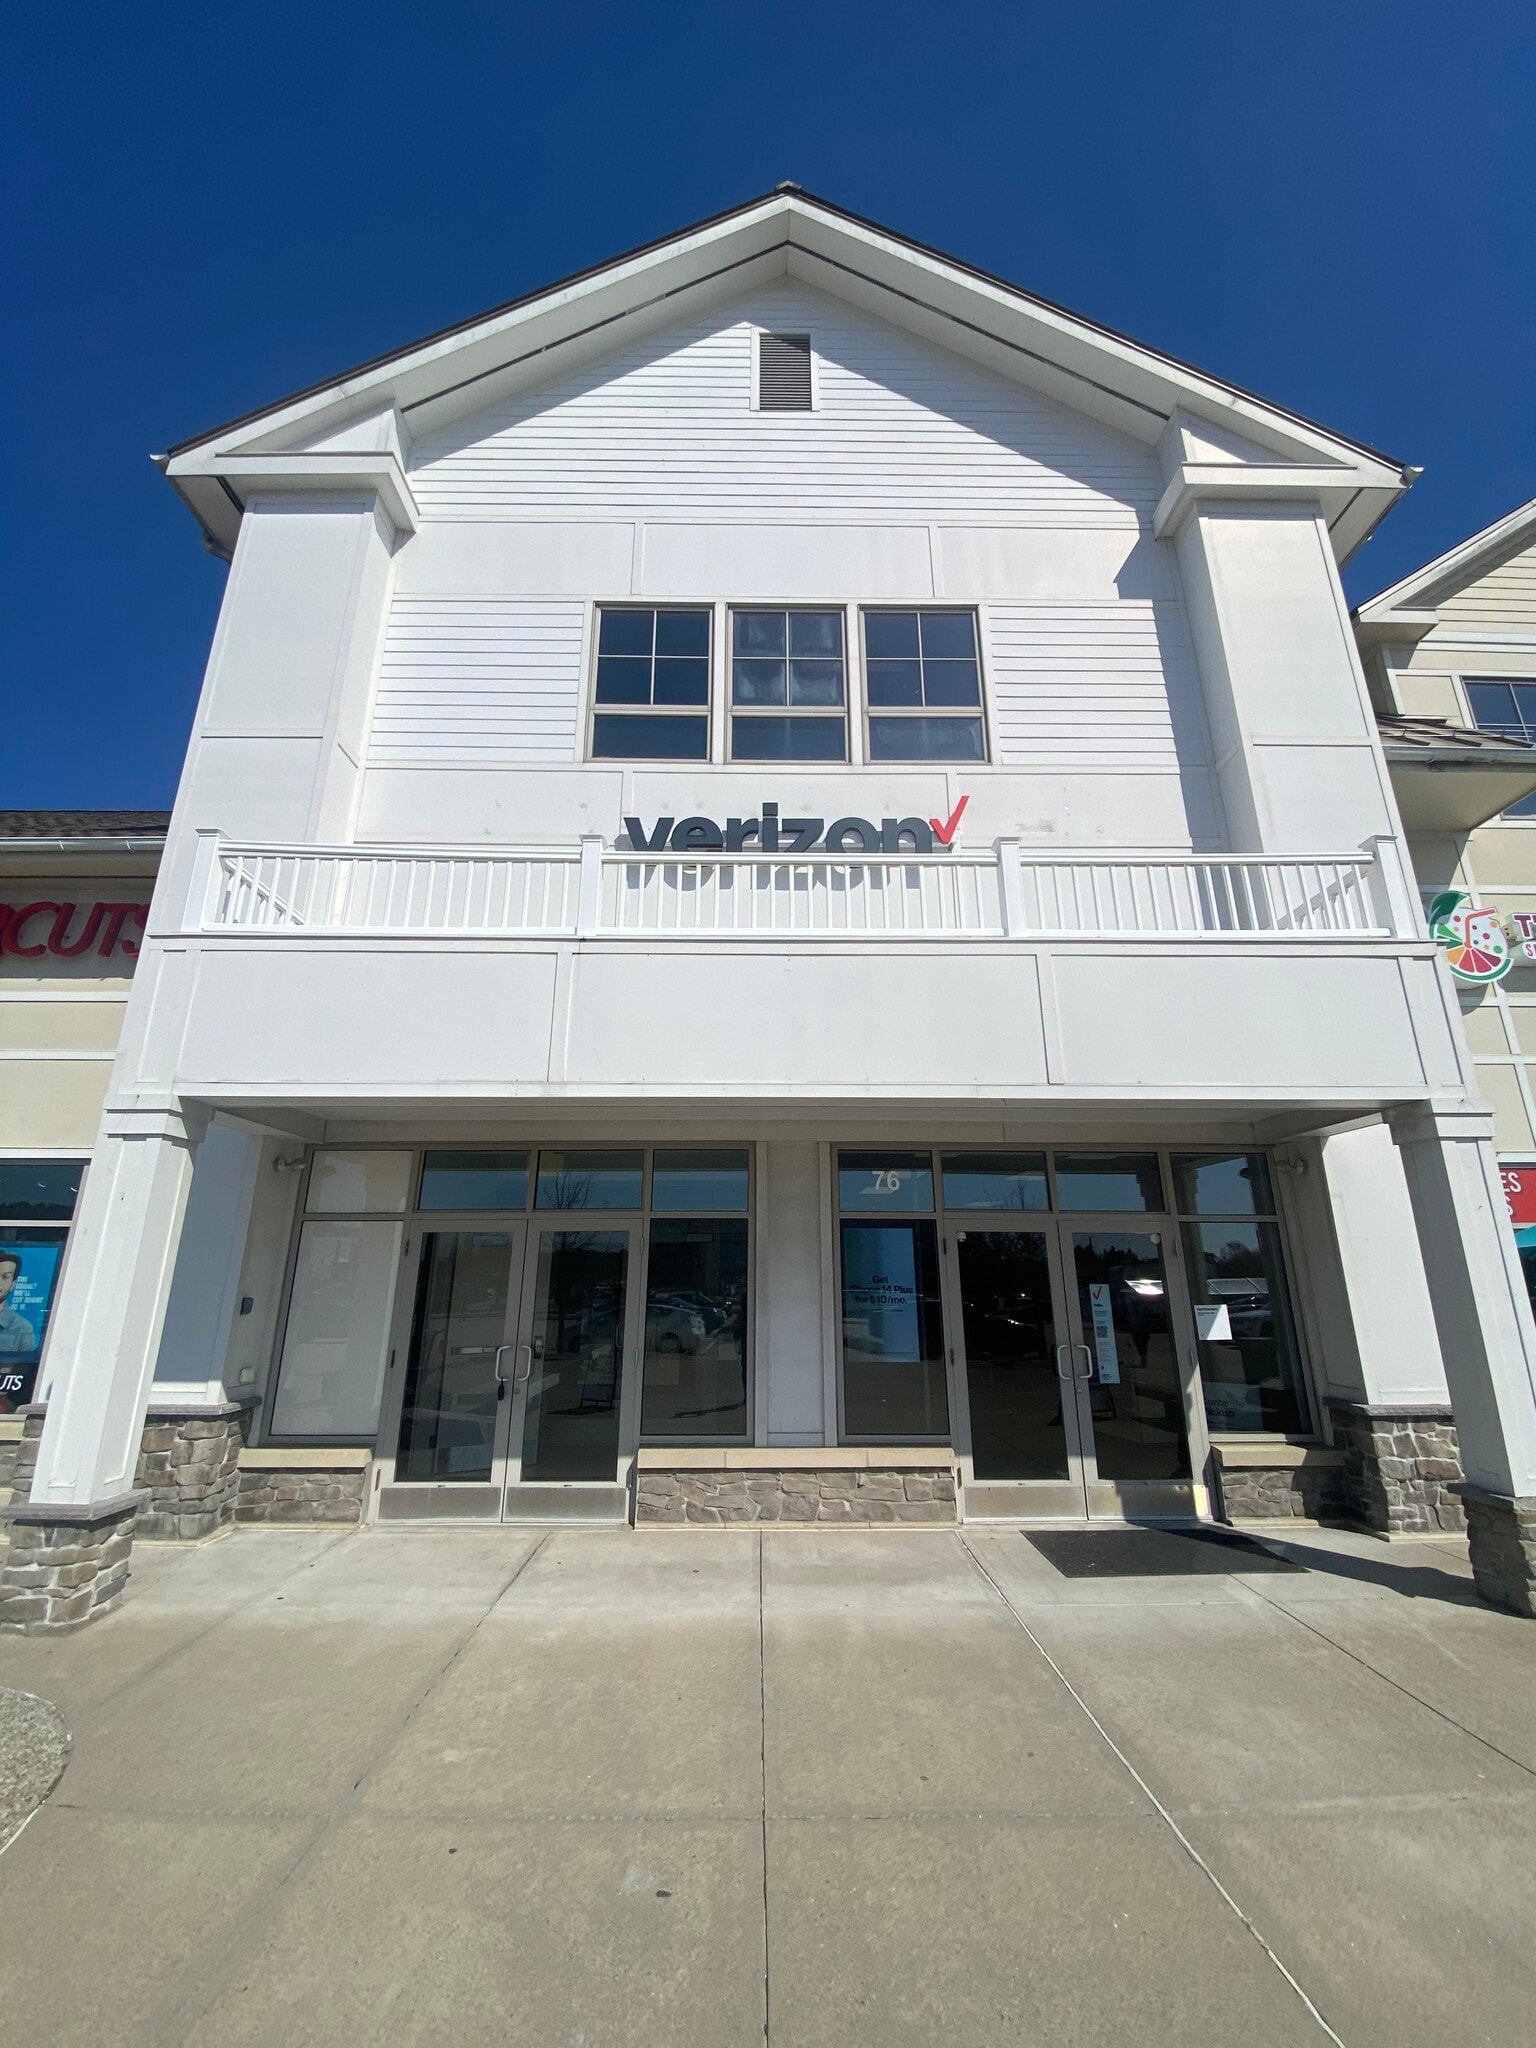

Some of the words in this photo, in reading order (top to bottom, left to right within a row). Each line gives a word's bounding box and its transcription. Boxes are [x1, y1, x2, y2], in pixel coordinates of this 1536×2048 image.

[624, 802, 932, 853] verizon
[0, 901, 150, 957] CUT
[871, 1170, 900, 1190] 76
[872, 1275, 889, 1284] Get
[893, 1285, 914, 1294] Plus
[855, 1295, 868, 1304] for
[1206, 1408, 1235, 1418] ickup
